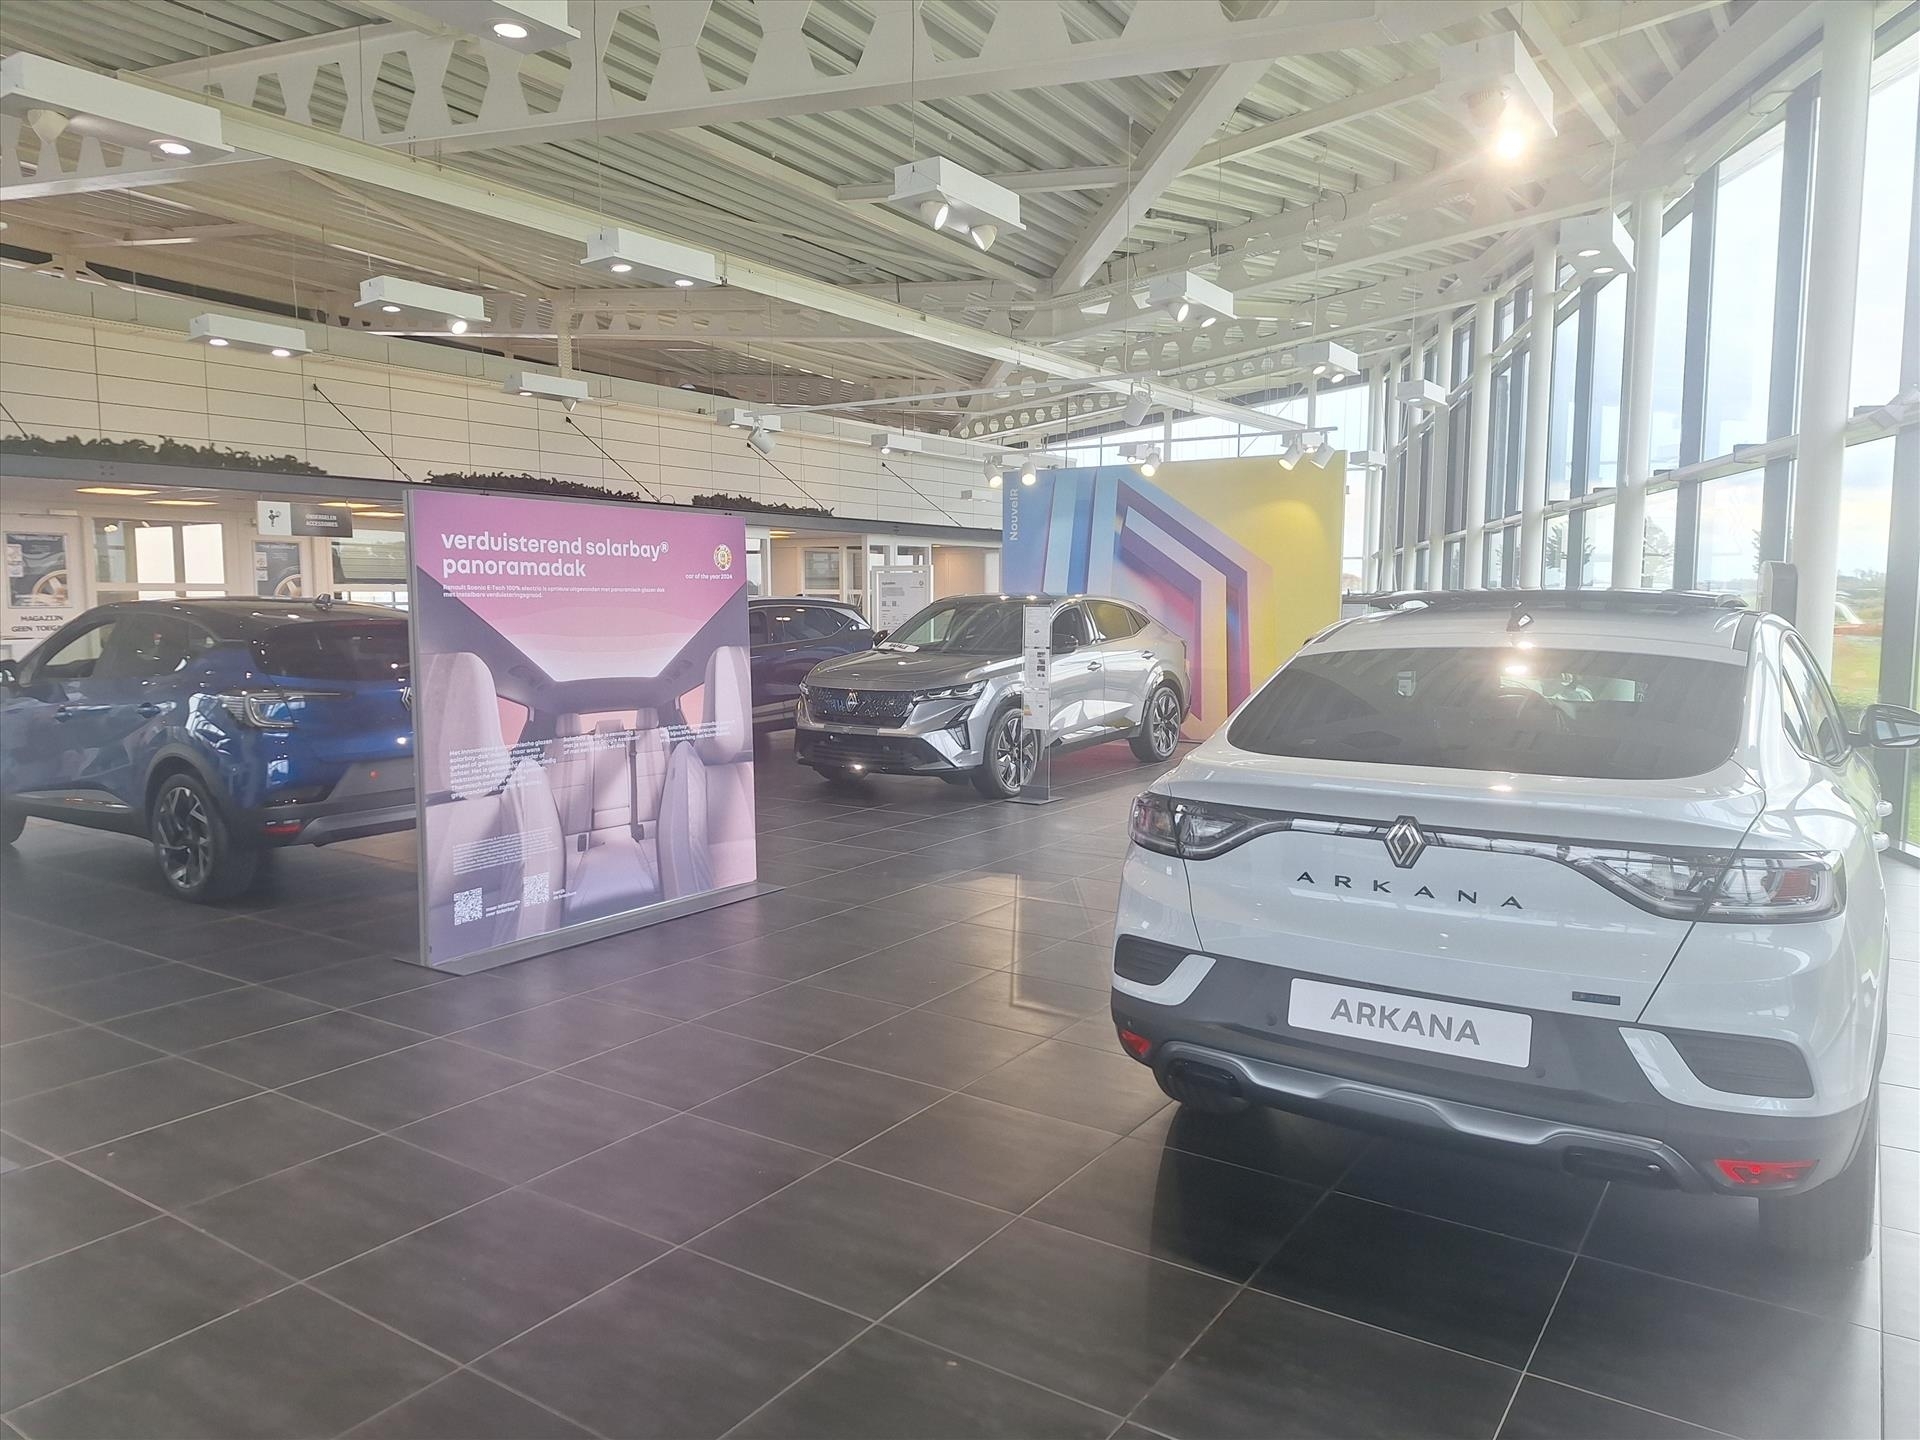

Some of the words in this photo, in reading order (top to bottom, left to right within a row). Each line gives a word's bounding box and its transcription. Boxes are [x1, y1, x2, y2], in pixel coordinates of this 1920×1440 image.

[441, 531, 582, 555] verduisterend
[443, 558, 586, 579] panoramadak
[11, 625, 33, 633] GEEN
[1296, 871, 1523, 909] ARKANA
[1330, 998, 1481, 1046] ARKANA
